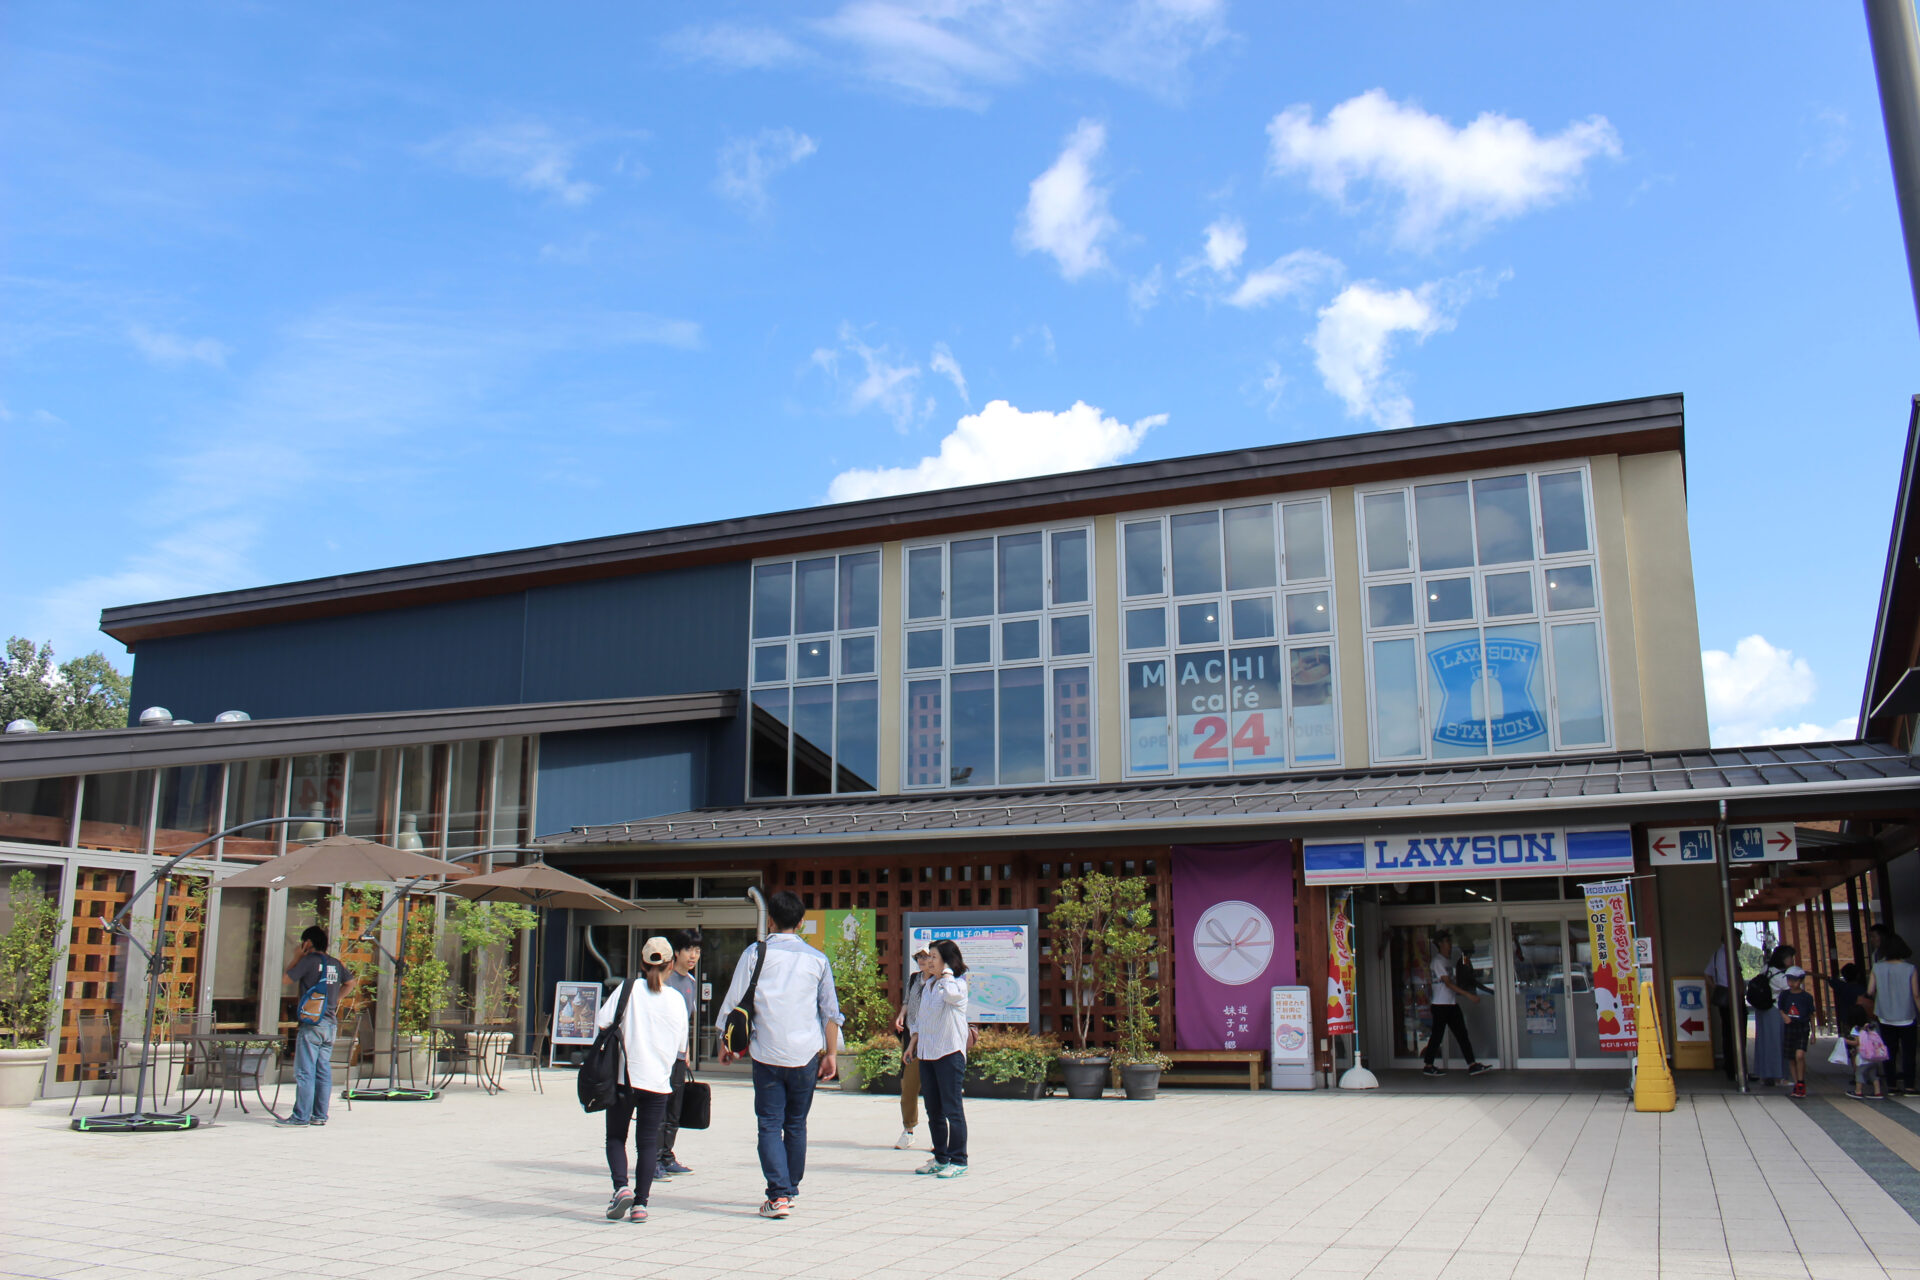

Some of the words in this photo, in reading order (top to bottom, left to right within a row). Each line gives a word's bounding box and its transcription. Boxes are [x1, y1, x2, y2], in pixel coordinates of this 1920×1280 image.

[1142, 655, 1265, 688] MACHI
[1440, 646, 1529, 669] LAWSON
[1191, 685, 1260, 713] café
[1192, 712, 1271, 760] 24
[1445, 716, 1534, 738] STATION
[1374, 832, 1557, 869] LAWSON
[1222, 1005, 1237, 1050] 妹子の郷
[1238, 1005, 1248, 1033] 道の駅
